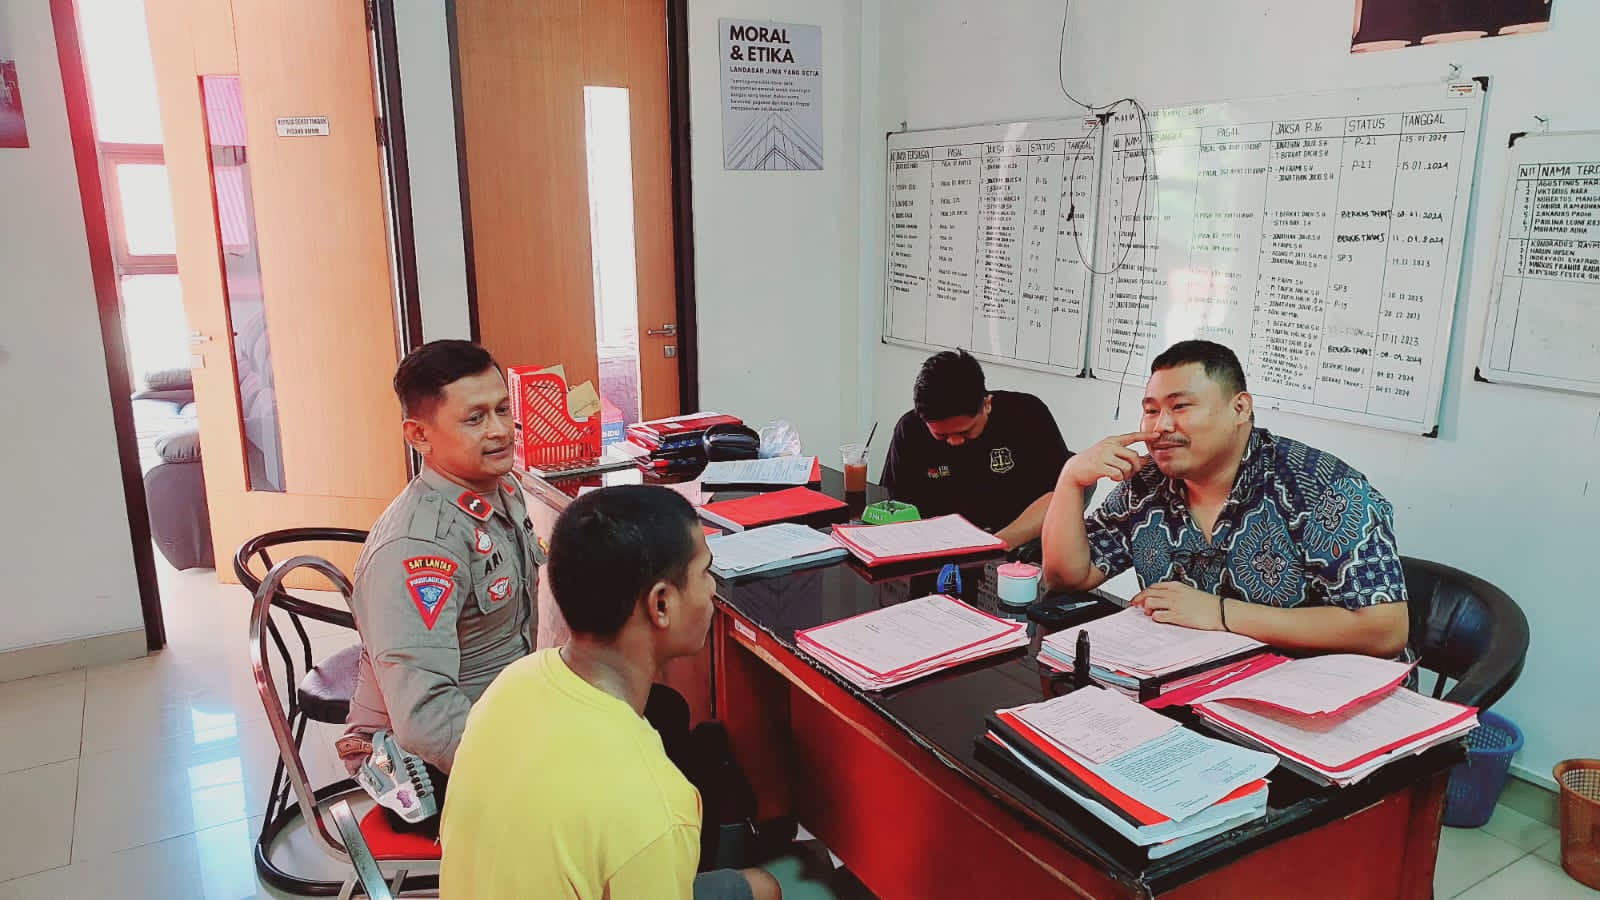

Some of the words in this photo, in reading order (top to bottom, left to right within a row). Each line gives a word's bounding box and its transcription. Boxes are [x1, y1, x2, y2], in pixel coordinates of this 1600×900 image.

[729, 25, 790, 44] MORAL
[730, 45, 744, 61] &
[748, 46, 795, 63] ETIKA
[730, 66, 764, 74] LANDASAN
[1348, 118, 1386, 132] STATUS
[1404, 113, 1446, 127] TANGGAL
[1275, 123, 1300, 135] JAKSA
[1030, 143, 1056, 153] STATUS
[1541, 166, 1571, 177] NAMA
[408, 559, 424, 571] SAT
[425, 558, 453, 573] LANTAS
[484, 549, 504, 577] ARI
